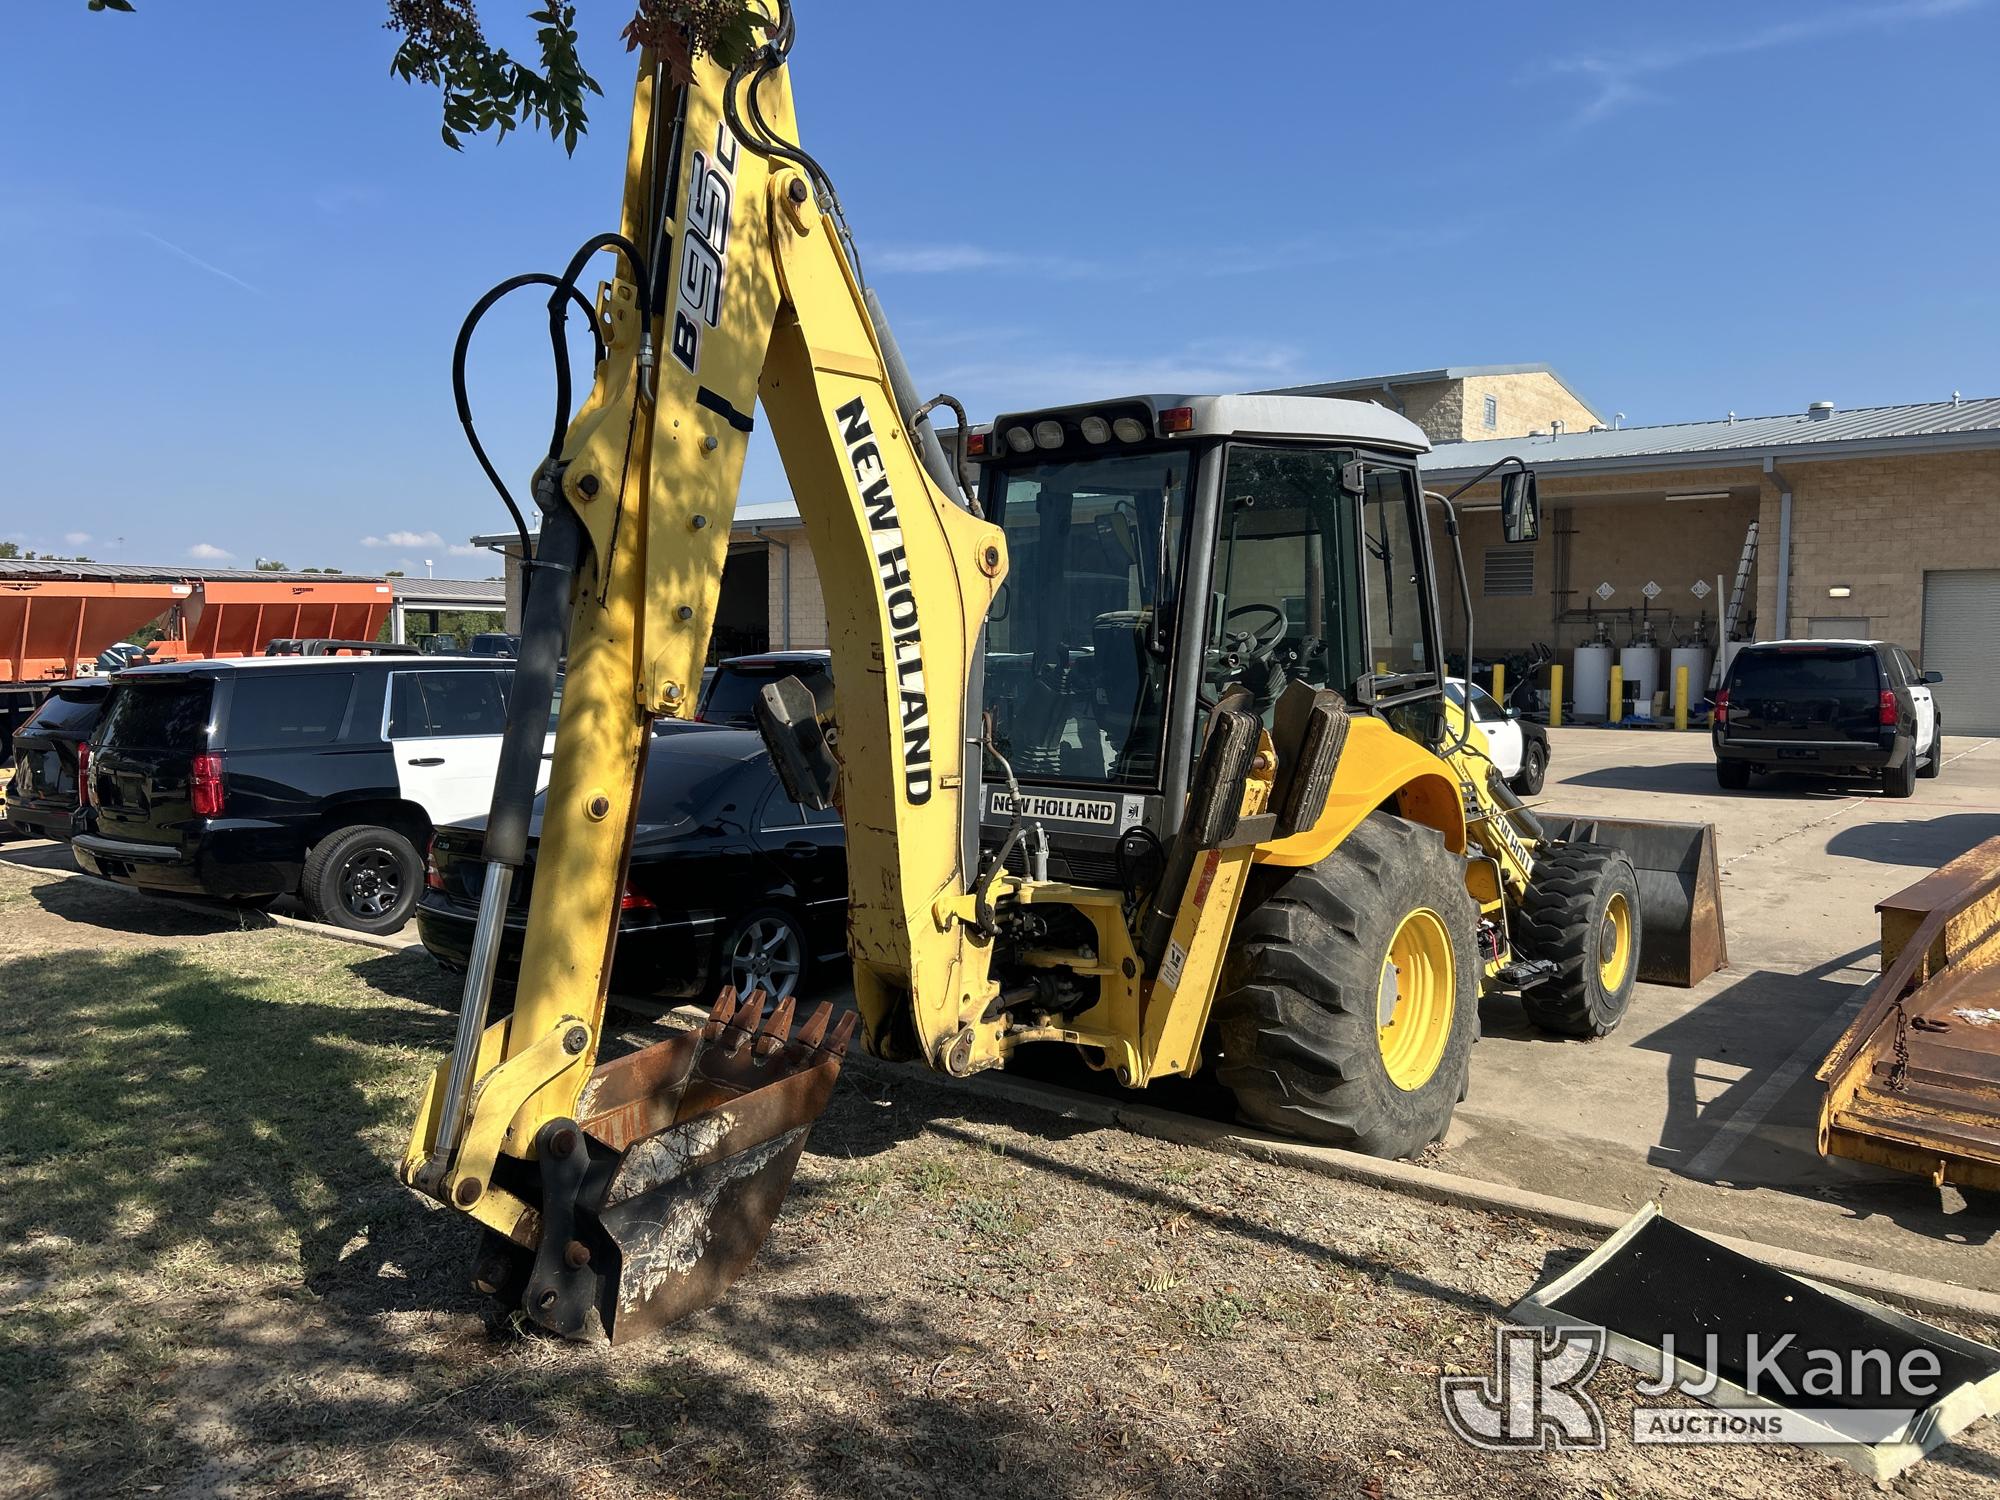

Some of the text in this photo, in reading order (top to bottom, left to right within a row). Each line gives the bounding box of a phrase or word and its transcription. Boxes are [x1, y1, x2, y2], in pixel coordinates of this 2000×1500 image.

[836, 396, 931, 806] NEW HOLLAND
[993, 795, 1112, 821] NEW HOLLAND
